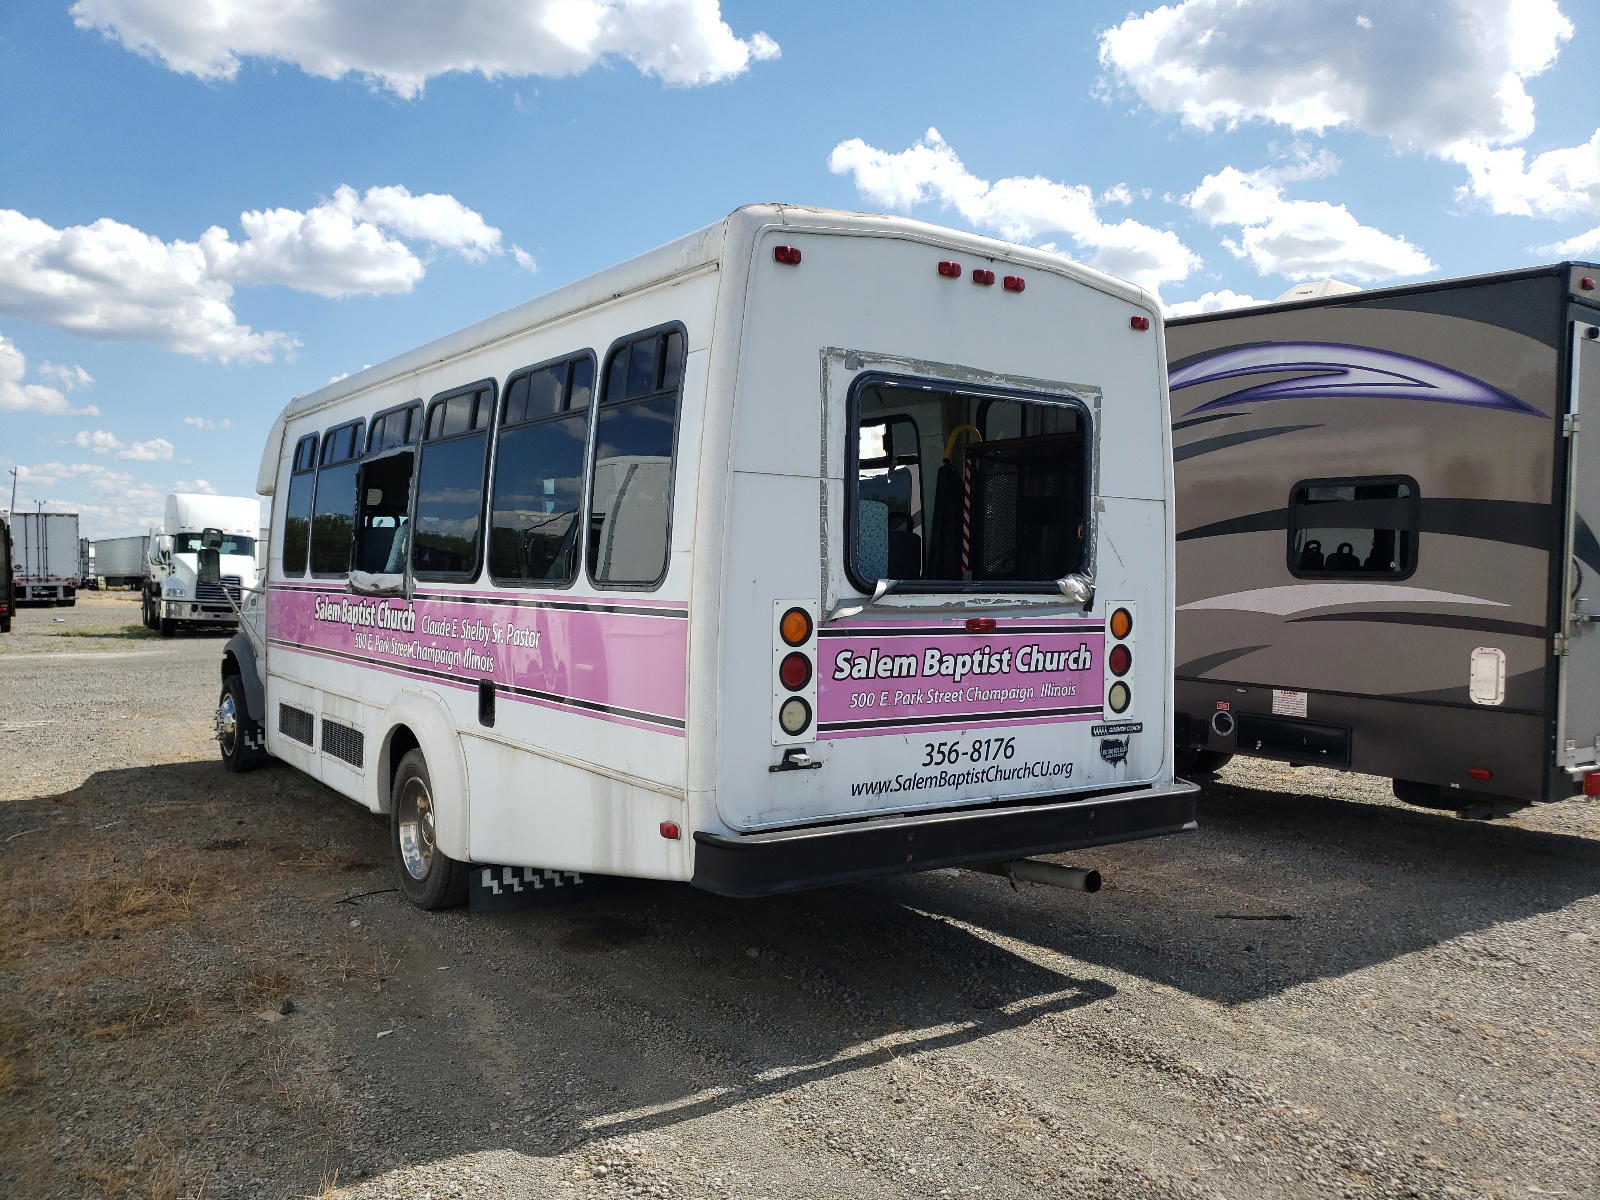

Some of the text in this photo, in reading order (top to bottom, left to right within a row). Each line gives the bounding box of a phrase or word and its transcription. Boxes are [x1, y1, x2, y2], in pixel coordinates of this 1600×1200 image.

[314, 595, 416, 634] Salem Baptist Church
[421, 614, 541, 649] Claude E. Shelby Sr. Pastor
[354, 632, 366, 650] 500
[374, 634, 390, 654] Park
[390, 636, 411, 658] Street
[463, 646, 494, 673] Illinois
[832, 643, 1093, 683] Salem Baptist Church
[849, 692, 876, 709] 500
[879, 691, 891, 707] E.
[894, 688, 923, 706] Park
[926, 688, 964, 704] Street
[1040, 682, 1077, 698] Illinois
[921, 736, 1016, 767] 356-8176
[851, 761, 1074, 797] www.SalemBaptistChurchCU.org
